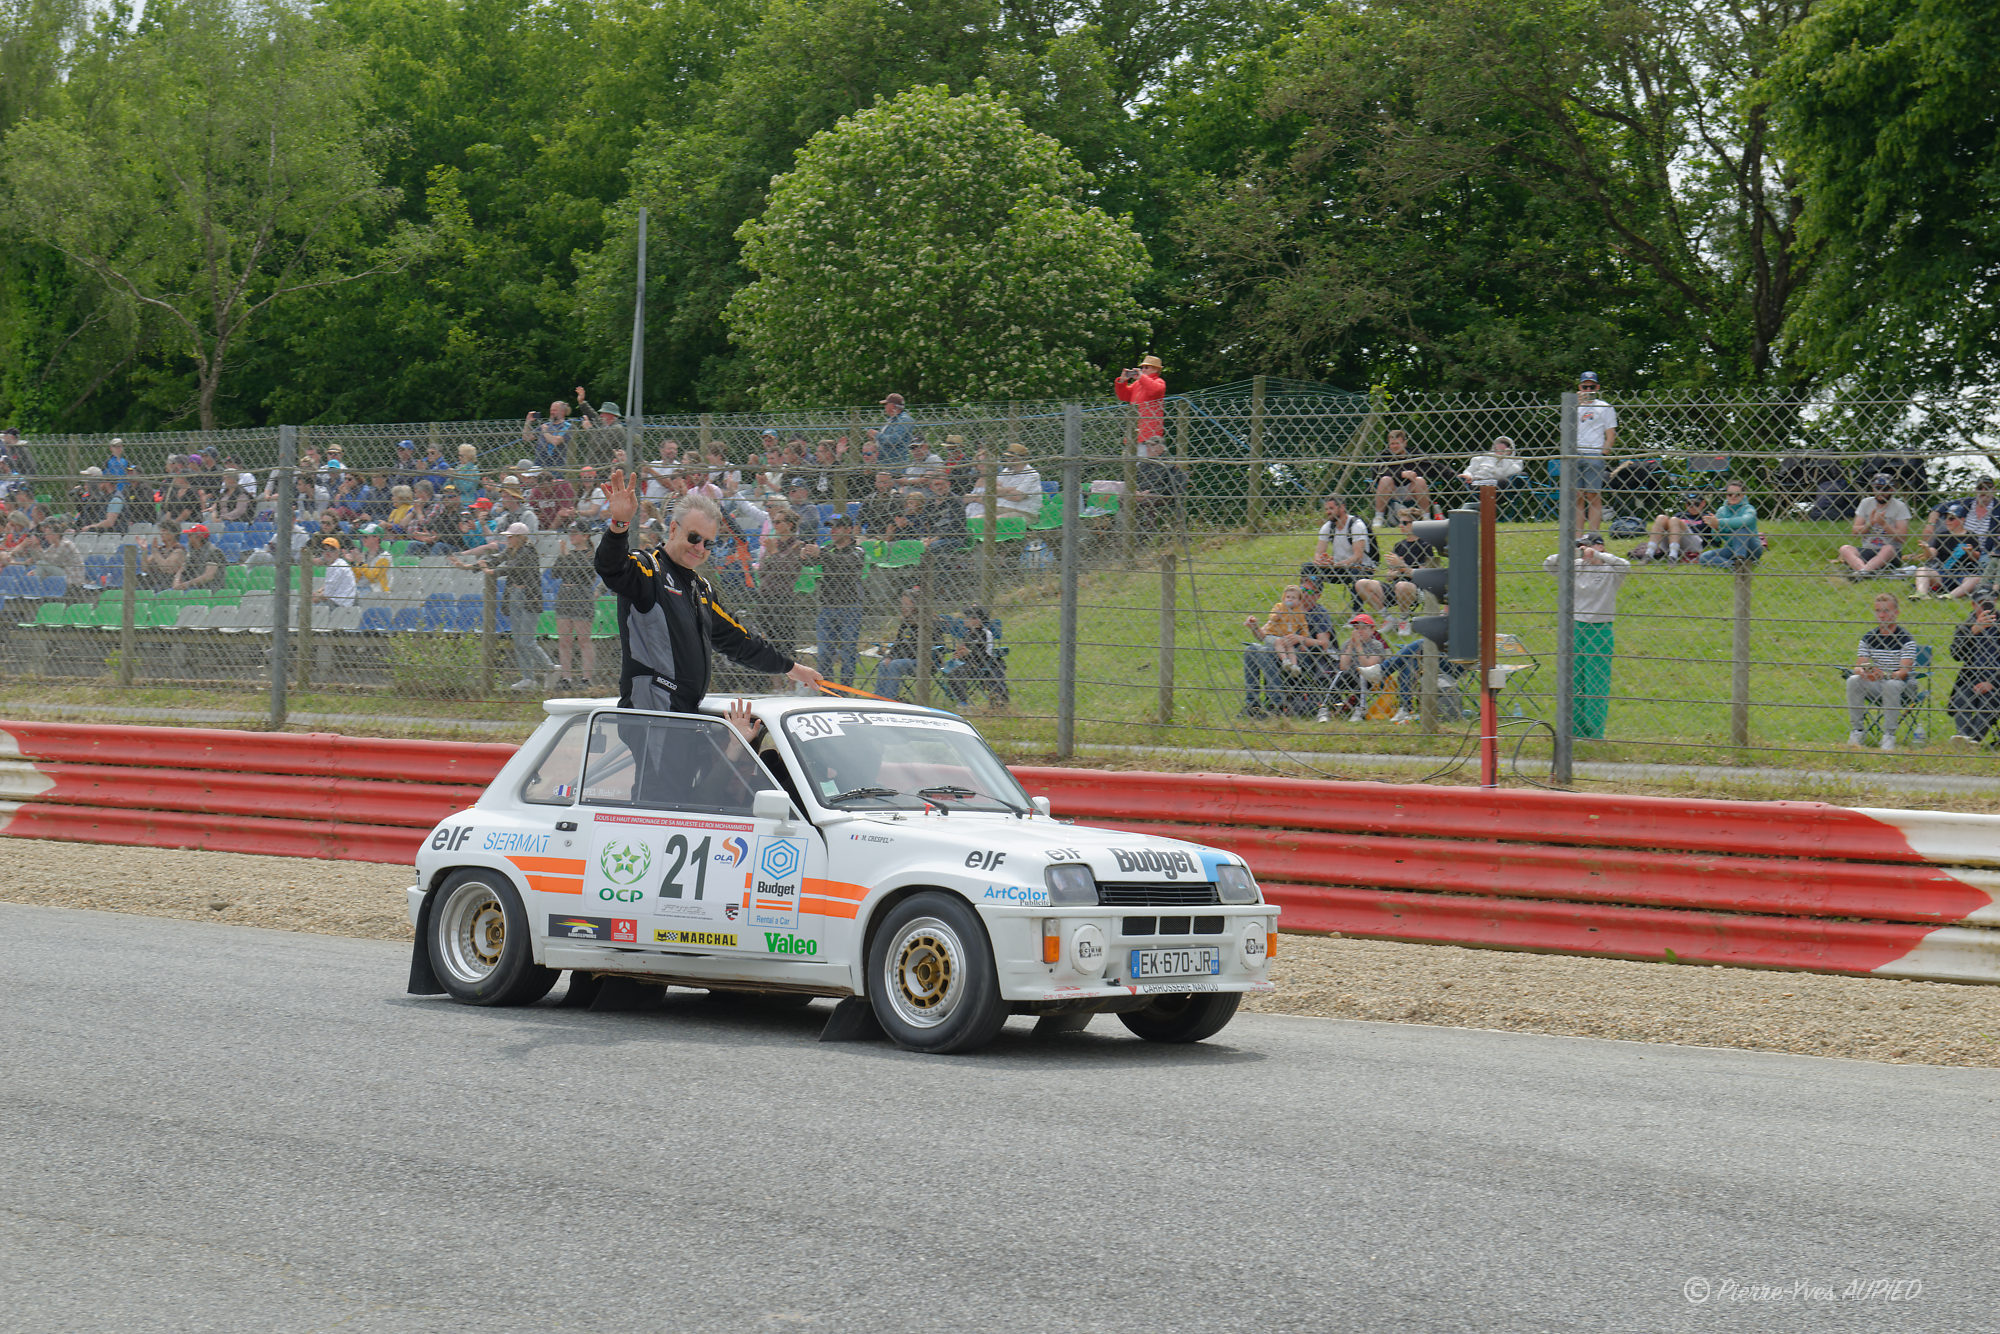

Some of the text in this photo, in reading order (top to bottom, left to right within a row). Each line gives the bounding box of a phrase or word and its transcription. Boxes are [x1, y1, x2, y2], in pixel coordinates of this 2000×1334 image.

[796, 714, 833, 737] 30
[631, 817, 660, 825] PATRONAGE
[715, 823, 747, 831] MOHAMMED
[431, 826, 474, 851] elf
[483, 832, 551, 854] SERMAT
[714, 854, 733, 862] OLA
[964, 850, 1007, 872] elf
[1044, 847, 1082, 861] elf
[658, 834, 711, 901] 21
[1106, 847, 1199, 880] Budget
[599, 888, 644, 903] OCP
[757, 881, 795, 897] Budget
[984, 885, 1048, 900] ArtColor
[756, 915, 774, 924] Rental
[780, 916, 790, 926] Car
[680, 931, 737, 946] MARCHAL
[764, 932, 817, 956] Valeo
